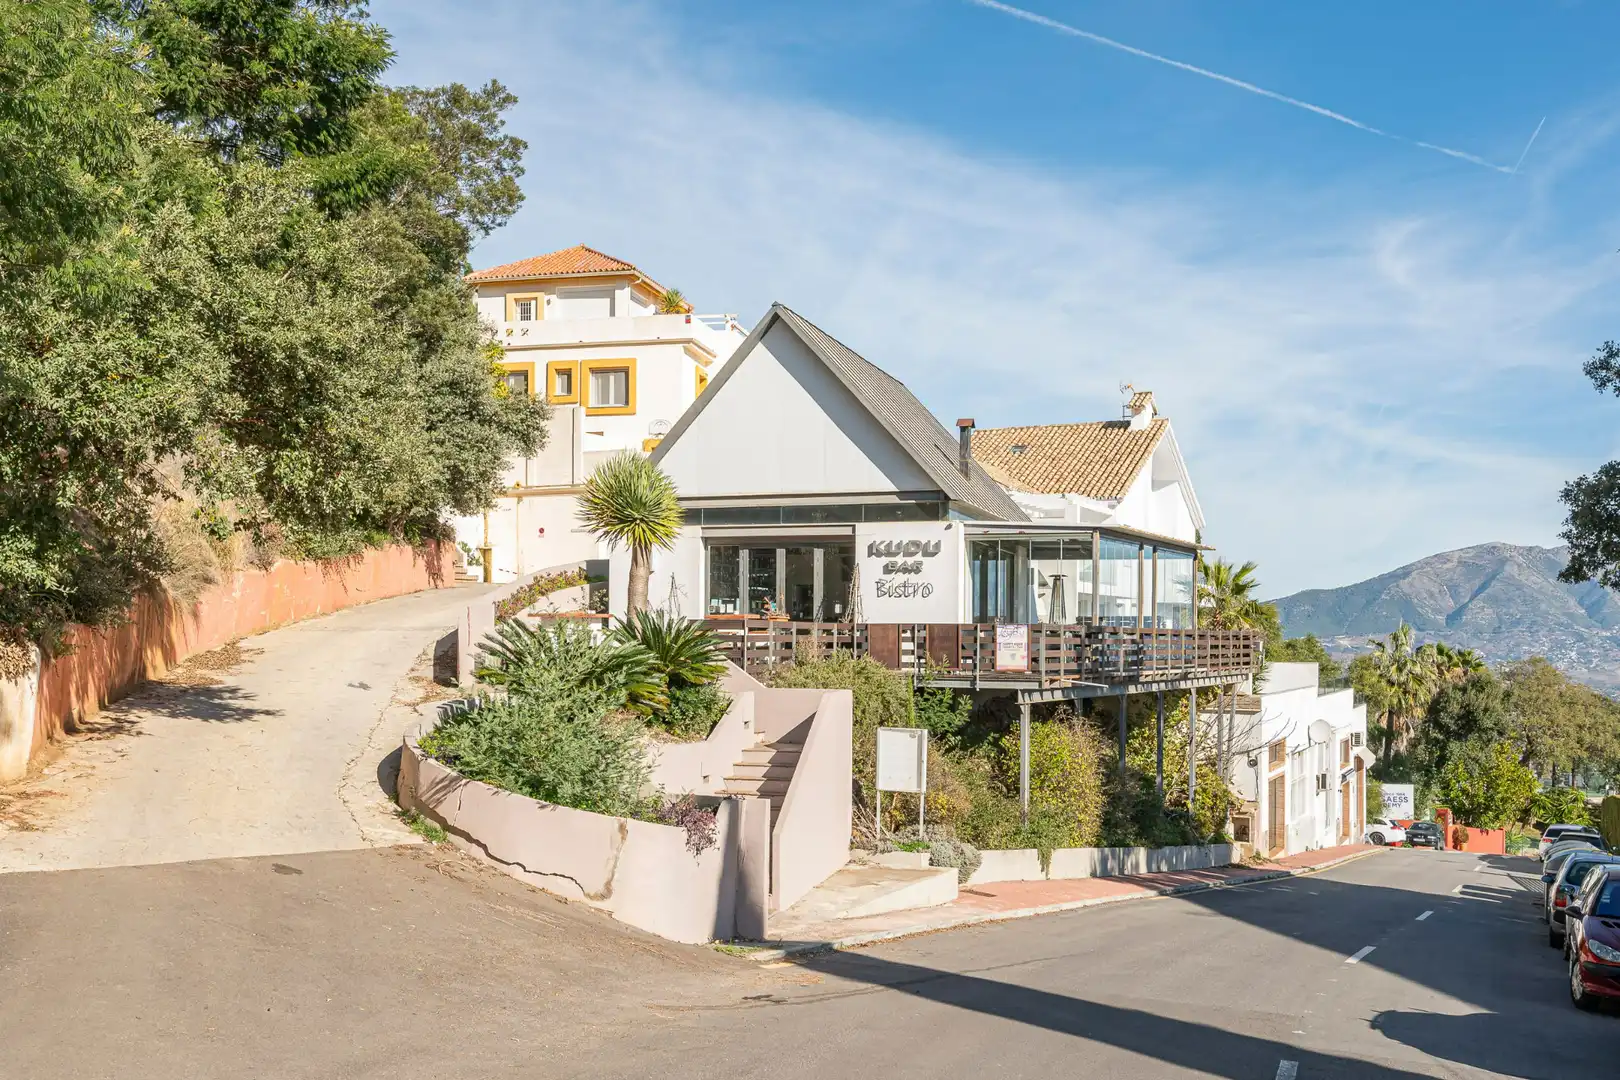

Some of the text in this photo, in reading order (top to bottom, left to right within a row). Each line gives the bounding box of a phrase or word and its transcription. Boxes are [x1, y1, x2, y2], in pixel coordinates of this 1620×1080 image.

[867, 540, 941, 558] KUDU
[883, 560, 924, 575] BAR
[875, 577, 934, 599] Bistro
